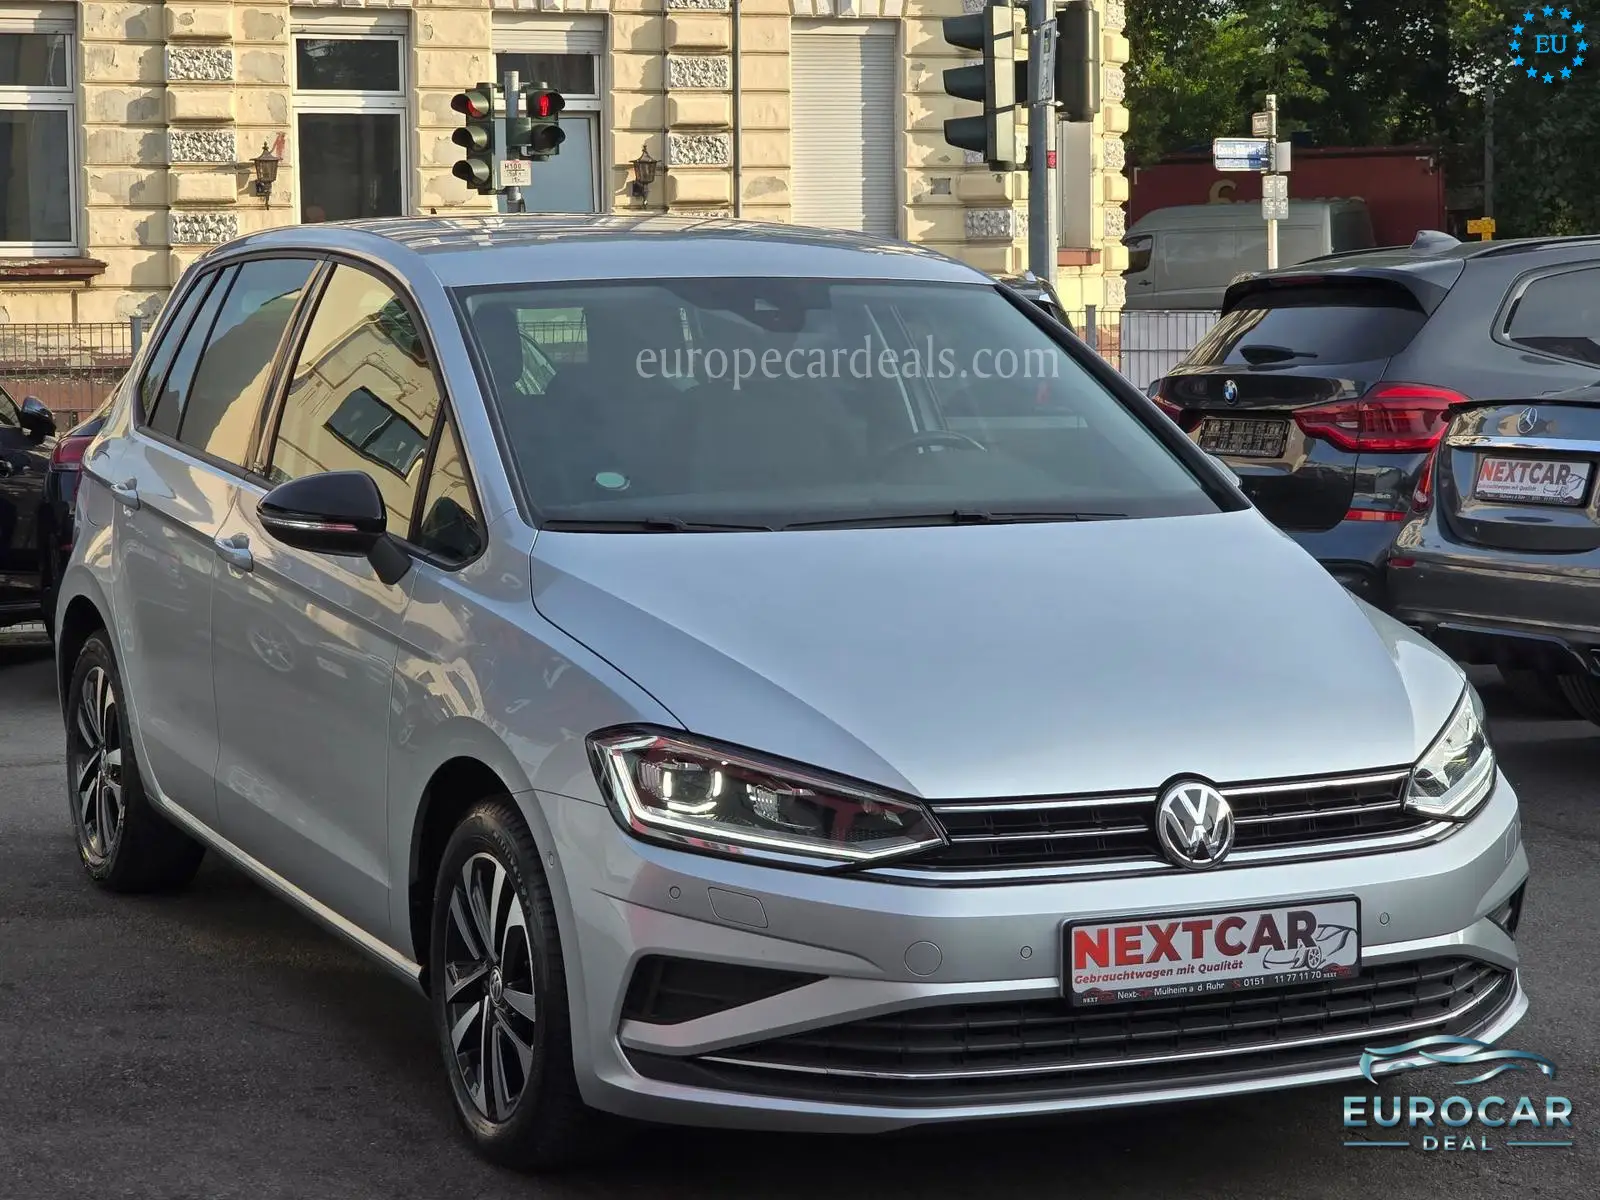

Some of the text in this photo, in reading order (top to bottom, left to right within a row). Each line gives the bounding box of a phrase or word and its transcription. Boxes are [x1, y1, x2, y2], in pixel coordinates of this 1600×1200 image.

[1480, 461, 1571, 485] NEXTCAR
[1074, 910, 1318, 969] NEXTCAR
[1074, 959, 1243, 984] Gebrauchtwagen mit Qualität
[1243, 977, 1265, 987] 0151
[1206, 982, 1225, 991] Ruhr
